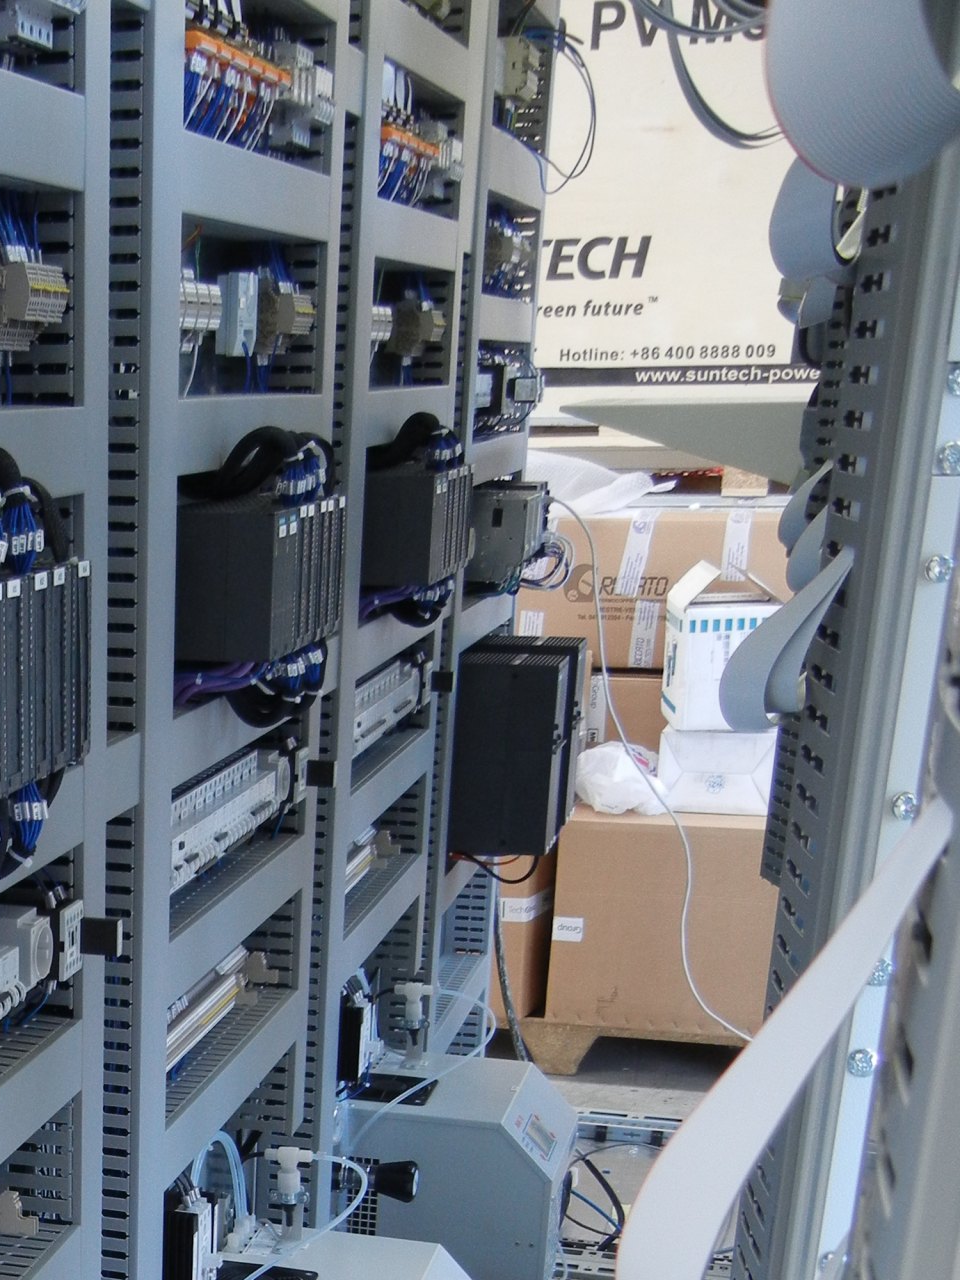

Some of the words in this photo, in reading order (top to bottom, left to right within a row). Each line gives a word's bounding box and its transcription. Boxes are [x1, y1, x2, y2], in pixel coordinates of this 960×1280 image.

[583, 300, 644, 317] future
[559, 348, 624, 363] Hotline:
[630, 347, 660, 361] +86
[664, 345, 695, 360] 400
[699, 344, 741, 359] 8888
[745, 344, 776, 358] 009
